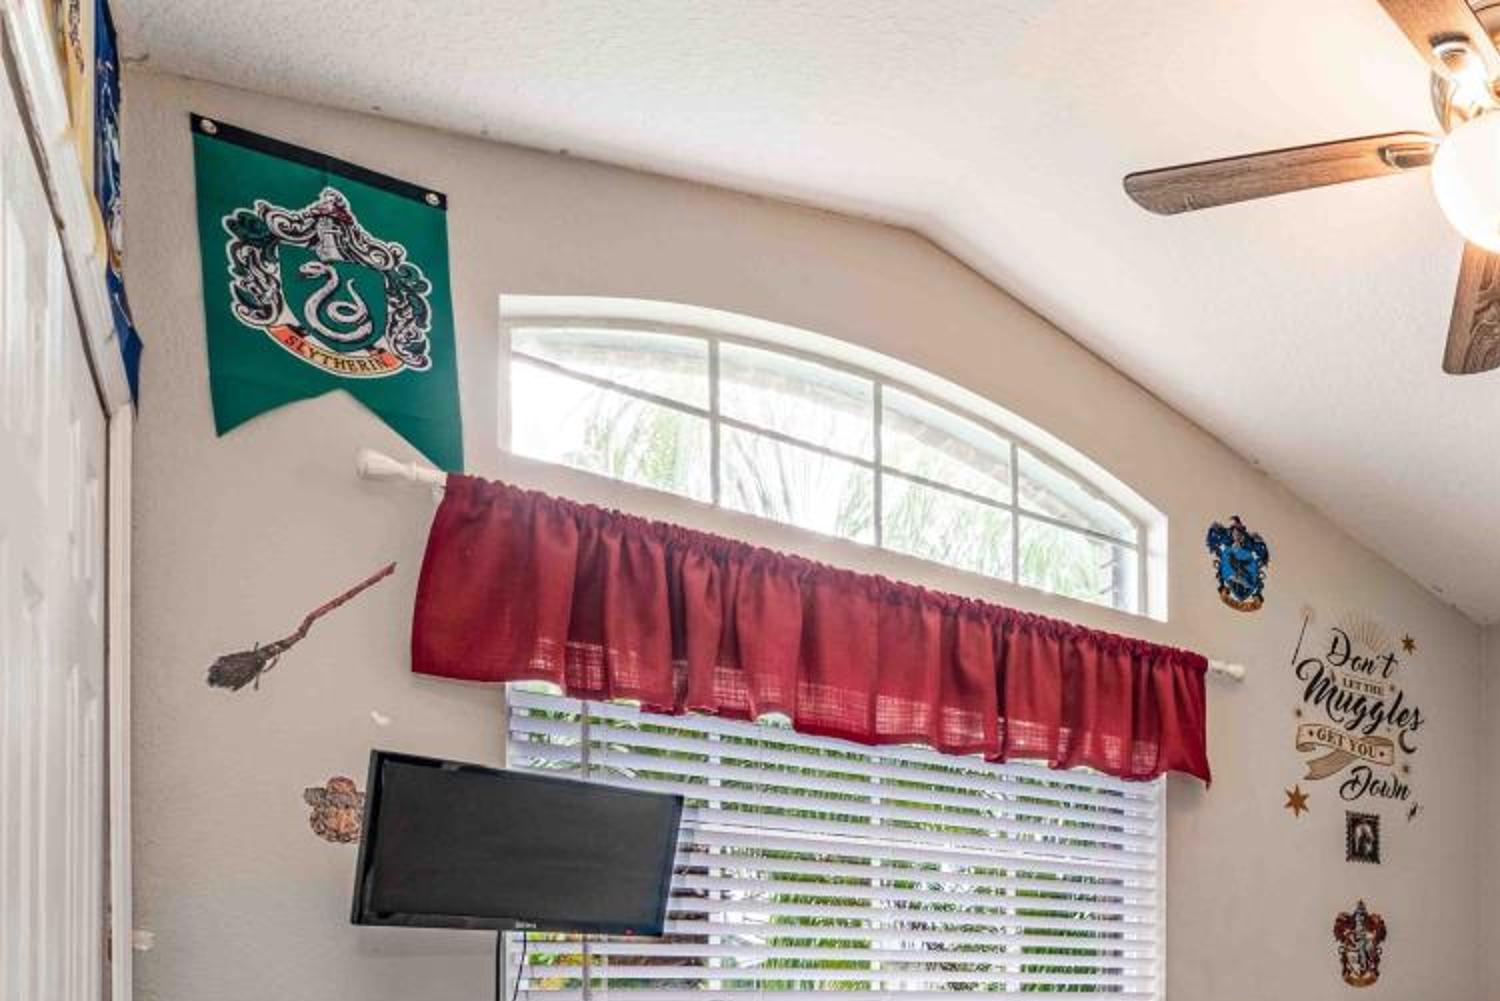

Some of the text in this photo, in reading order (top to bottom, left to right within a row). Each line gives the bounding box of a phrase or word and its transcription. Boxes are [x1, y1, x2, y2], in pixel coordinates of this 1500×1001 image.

[284, 335, 390, 372] SLYTHERIN
[1326, 627, 1399, 679] Don't
[1295, 658, 1425, 735] Muggles
[1316, 728, 1377, 758] GET YOU
[1339, 765, 1411, 801] Down
